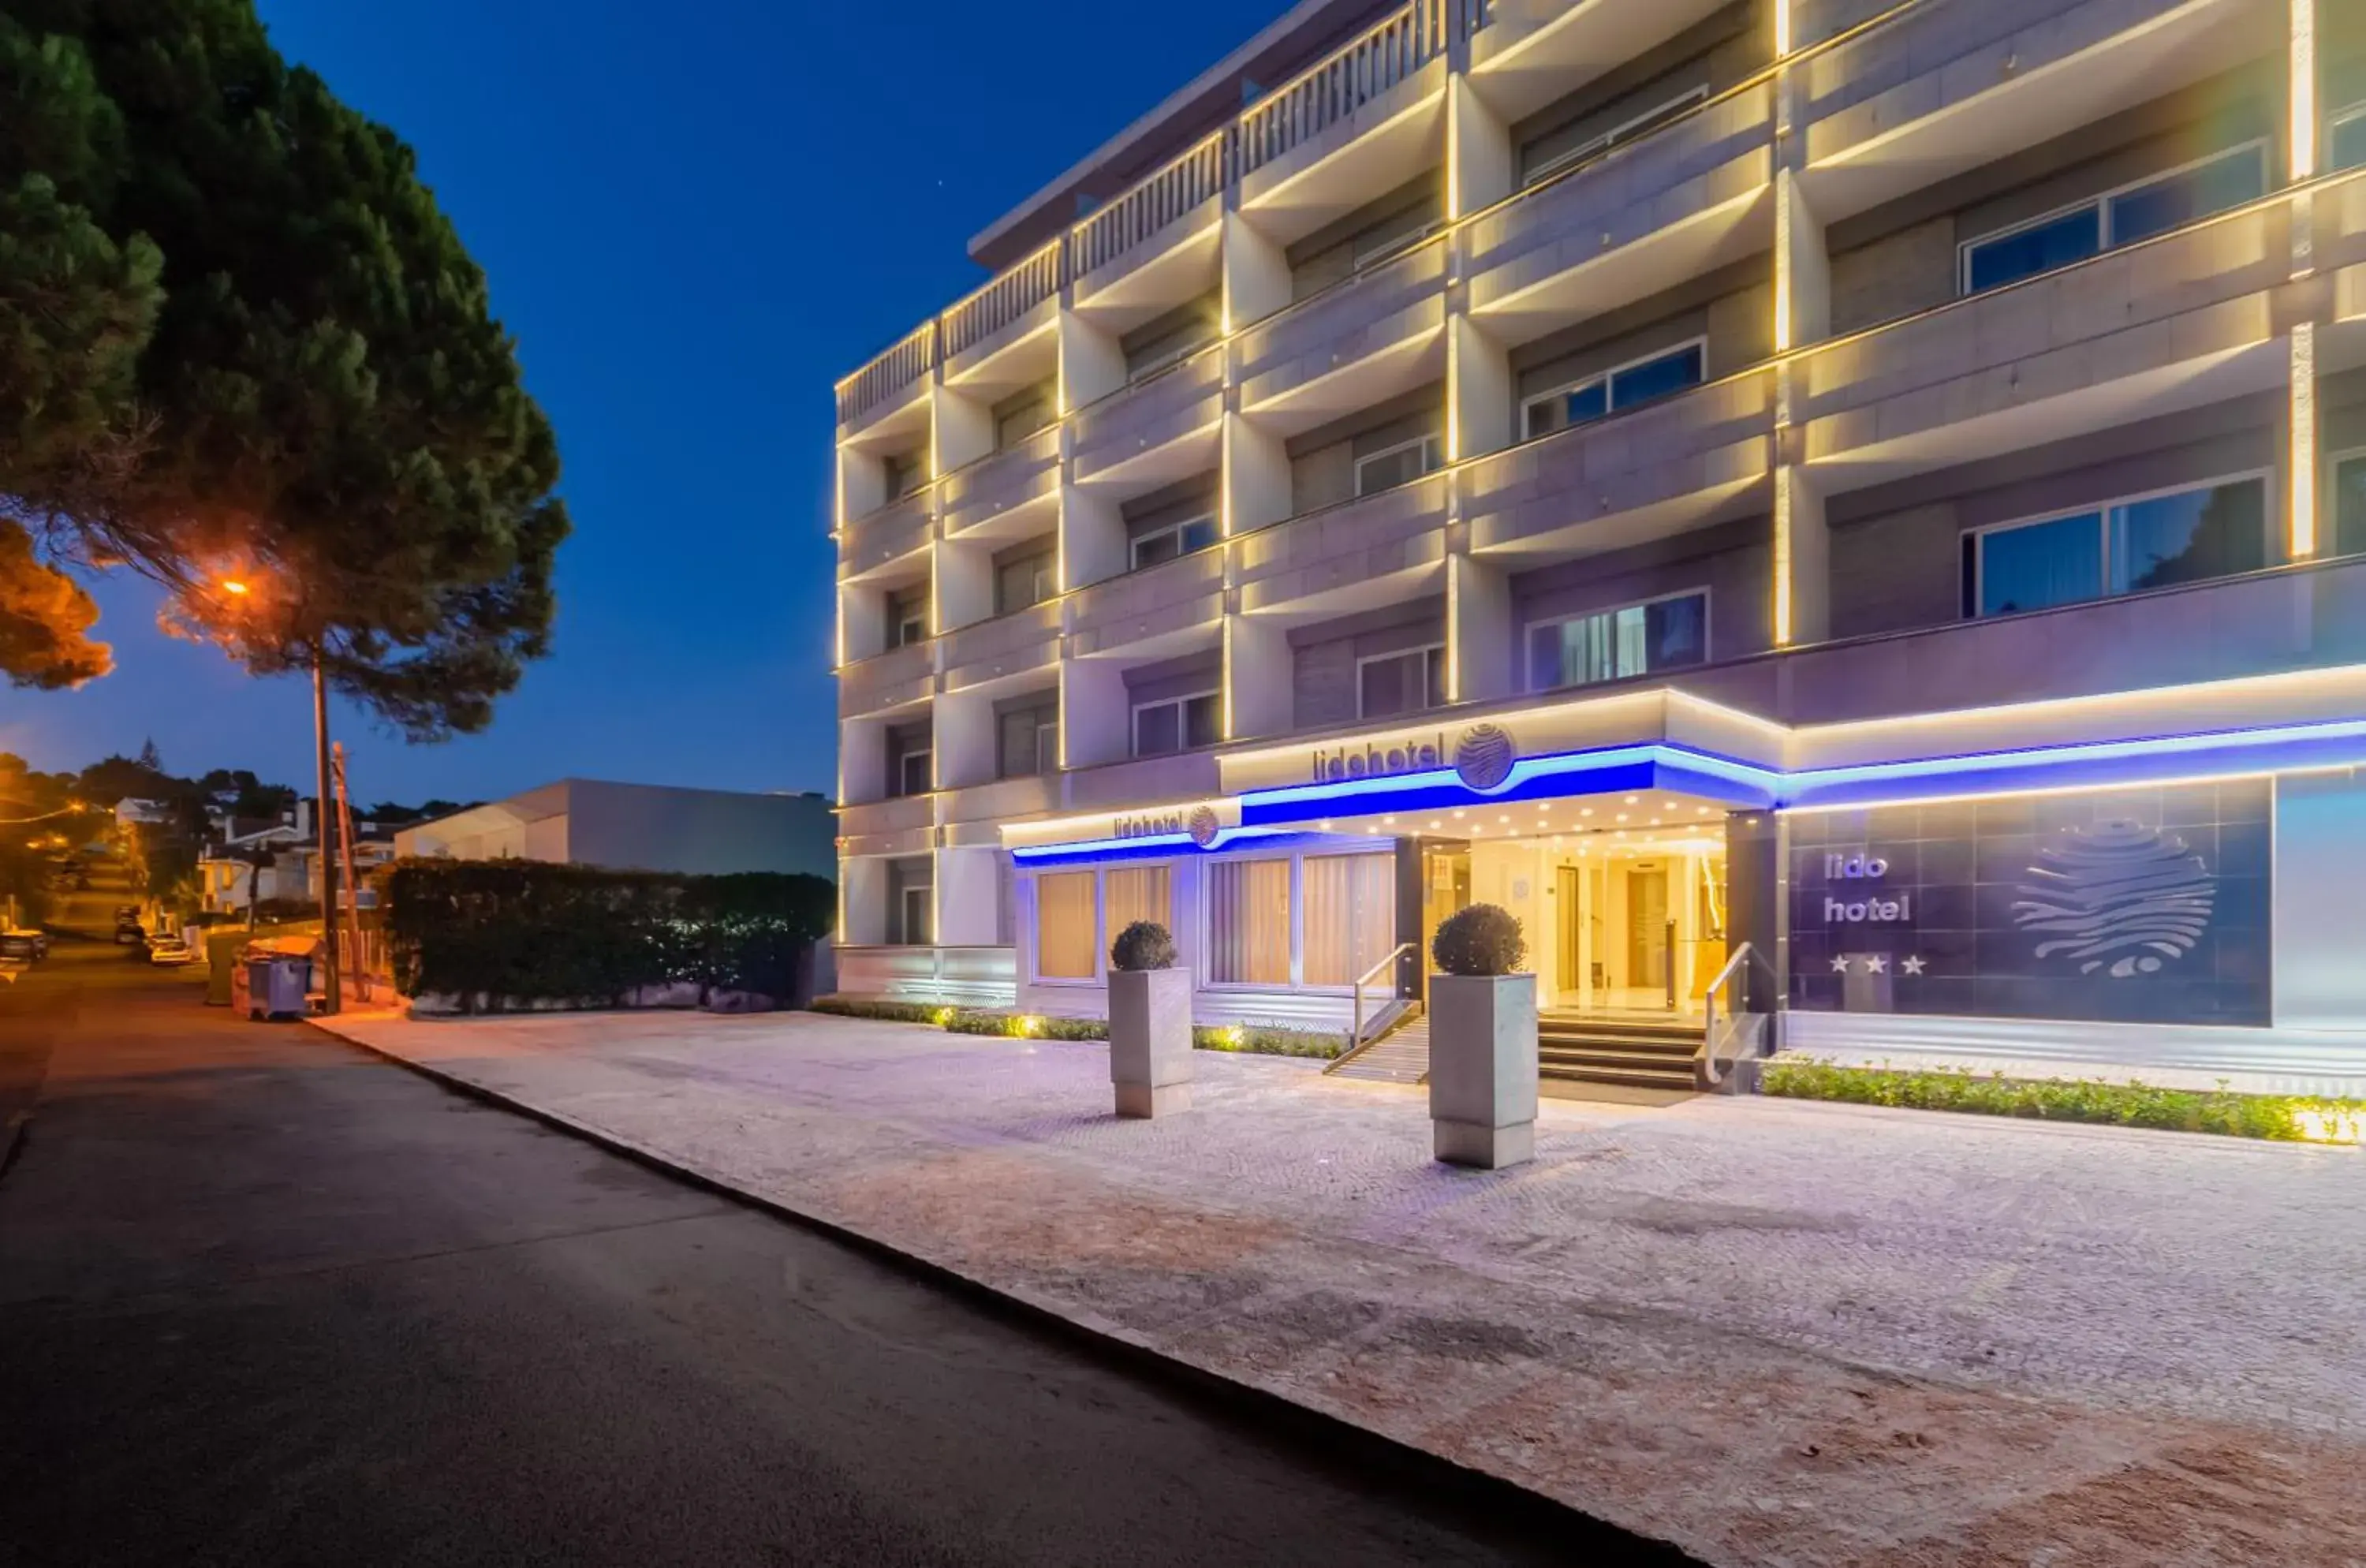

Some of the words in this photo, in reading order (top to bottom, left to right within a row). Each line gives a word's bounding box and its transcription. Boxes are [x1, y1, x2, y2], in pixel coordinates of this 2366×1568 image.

[1313, 732, 1444, 781] lidohotel
[1825, 853, 1888, 879] lido
[1825, 895, 1909, 922] hotel
